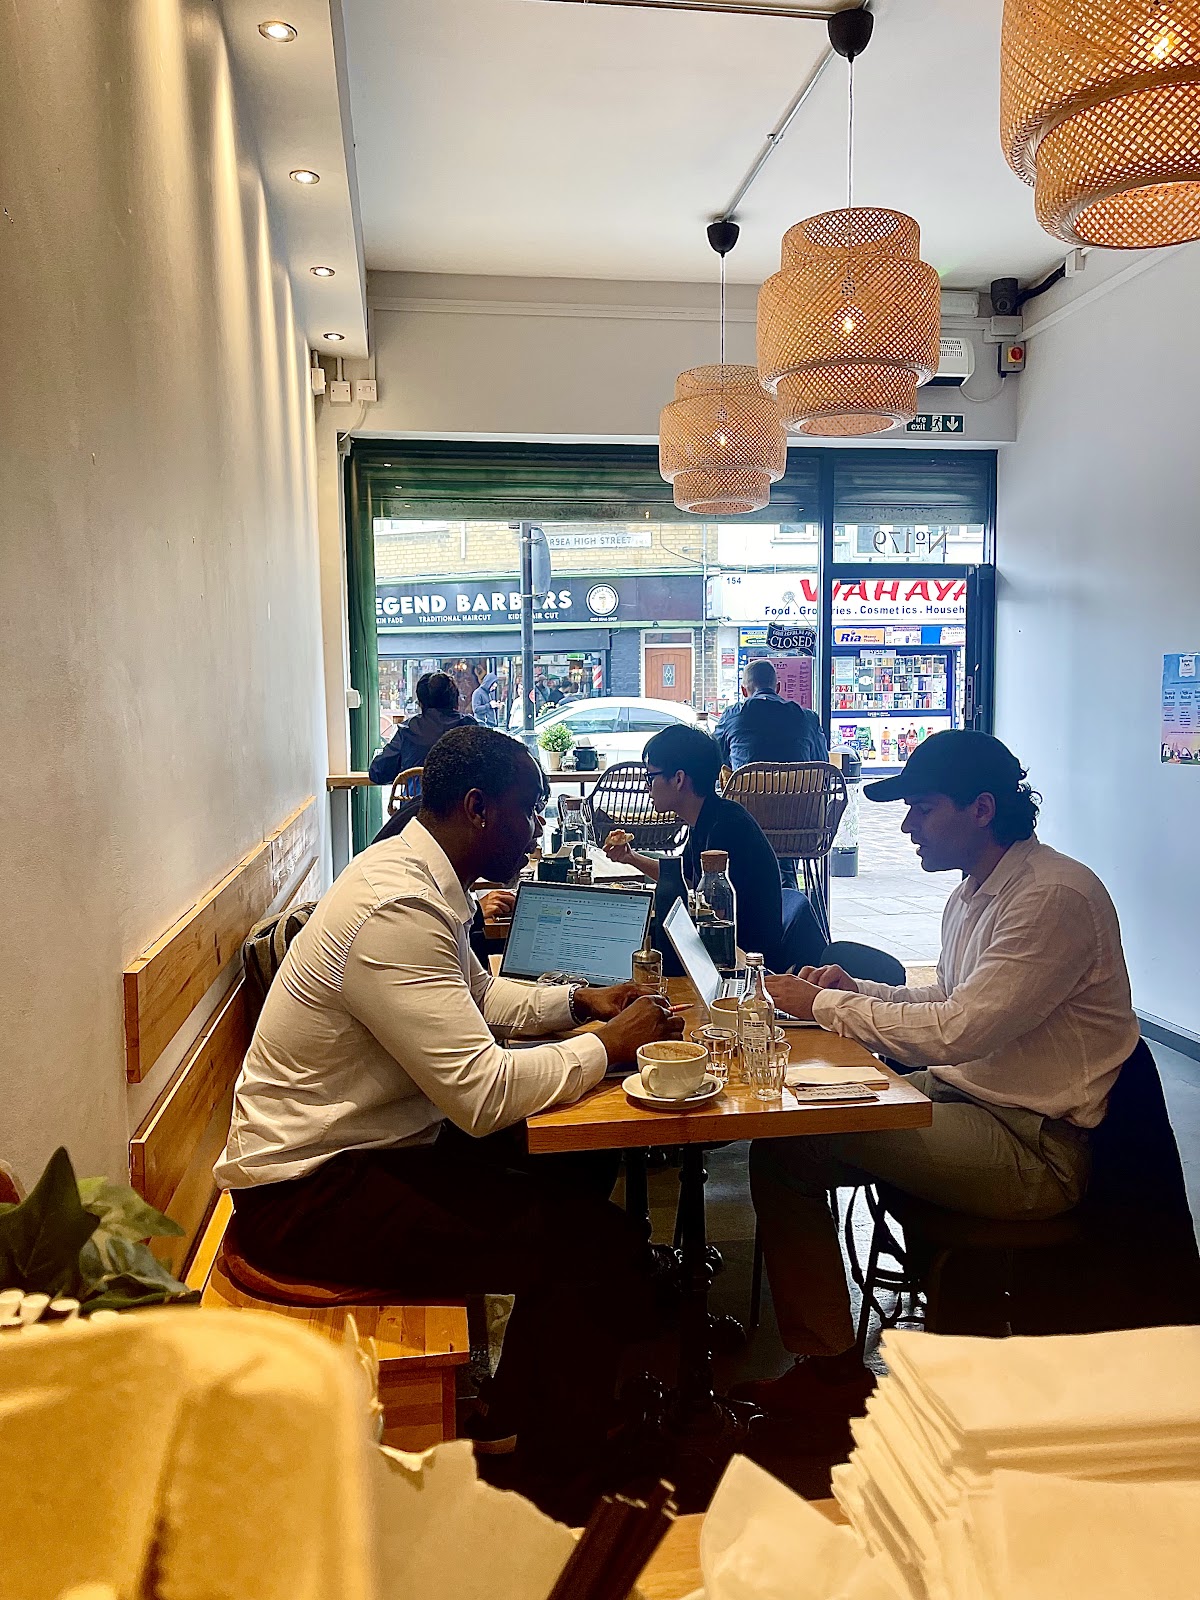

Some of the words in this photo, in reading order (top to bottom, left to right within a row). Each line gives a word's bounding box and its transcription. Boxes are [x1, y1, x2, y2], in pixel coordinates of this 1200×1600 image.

[574, 537, 596, 545] HIGH
[600, 536, 632, 545] STREET
[726, 577, 742, 585] 154
[375, 594, 447, 615] EGEND
[456, 589, 573, 613] BARBRS
[765, 606, 790, 615] Food
[860, 605, 918, 615] Cosmetics
[926, 605, 965, 614] Househ
[418, 615, 461, 623] TRADITIONAL
[462, 613, 492, 622] HAIRCUT
[544, 612, 559, 620] CUT
[840, 630, 862, 642] Ria
[770, 635, 812, 649] CLOSED
